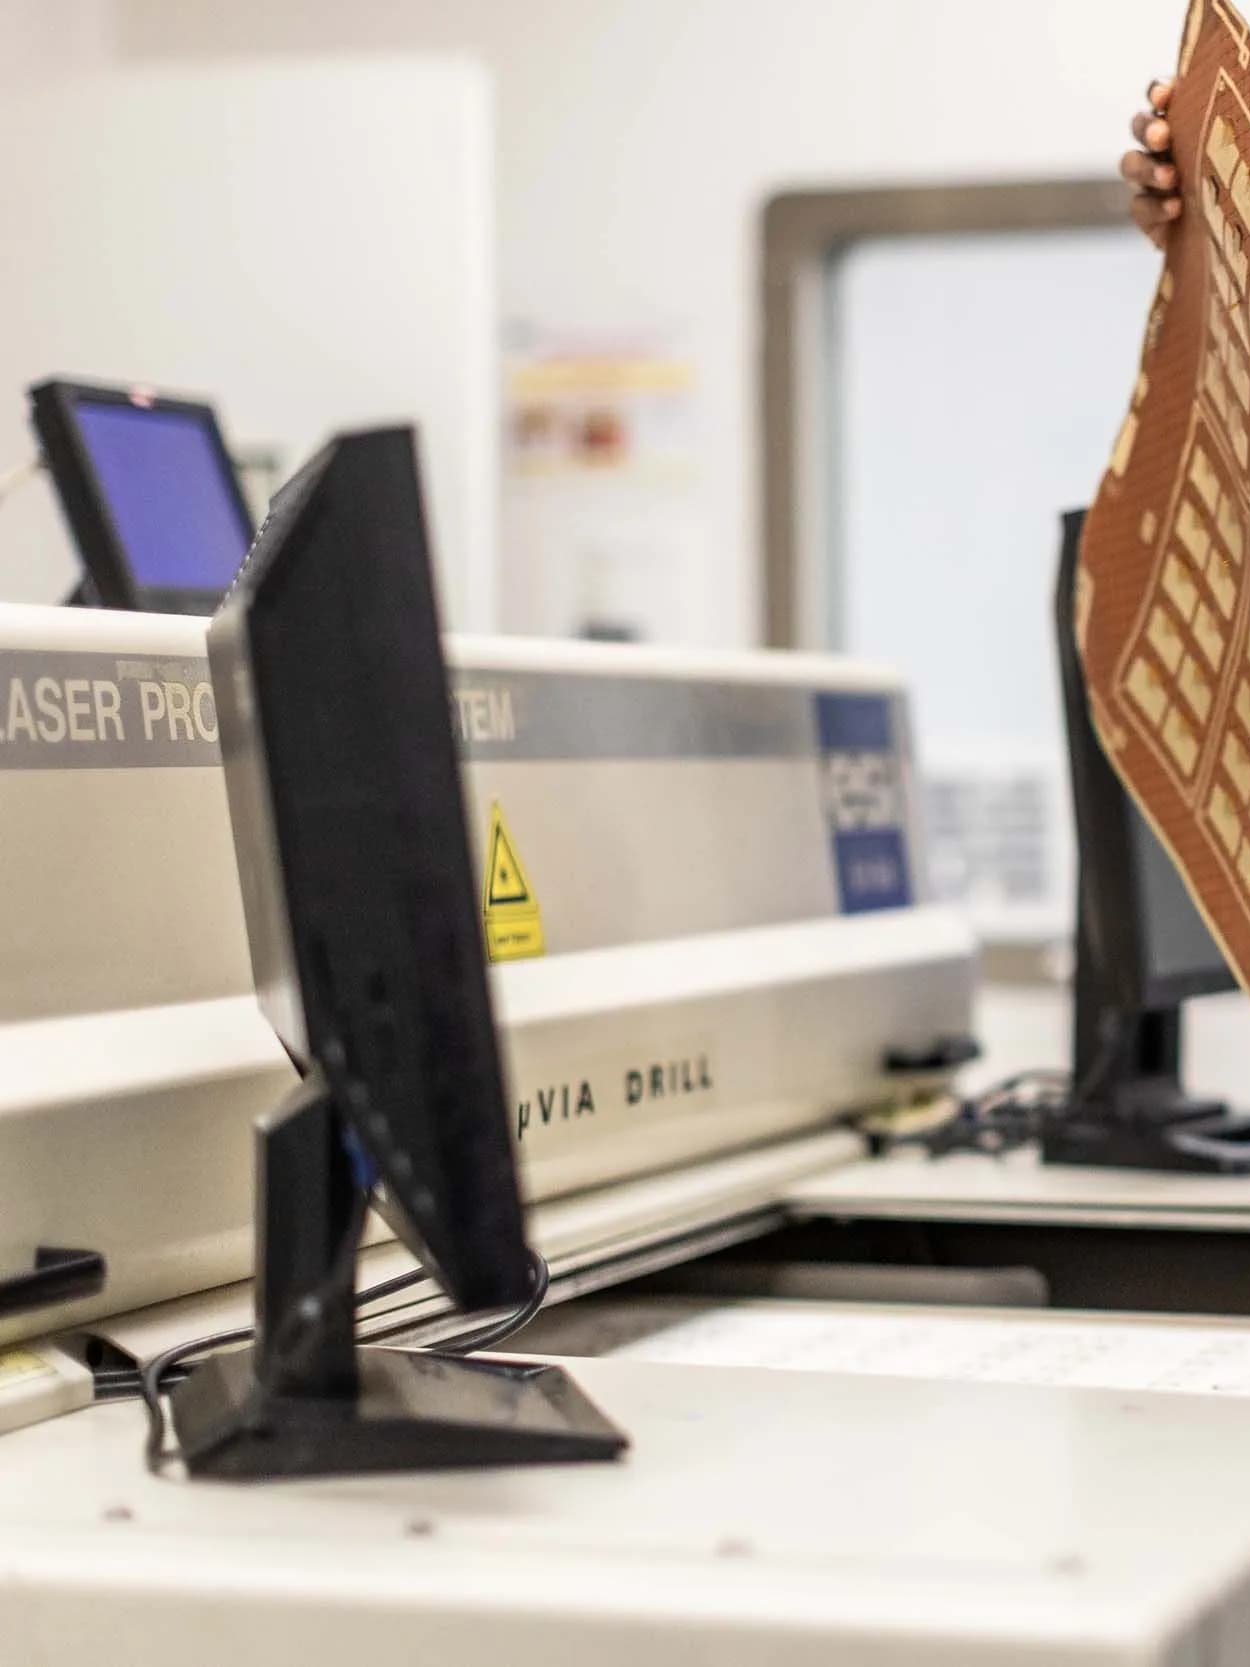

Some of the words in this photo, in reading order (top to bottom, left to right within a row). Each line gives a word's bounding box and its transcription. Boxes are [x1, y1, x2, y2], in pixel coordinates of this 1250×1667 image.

[0, 677, 125, 743] ASER
[138, 680, 219, 743] PRO
[451, 688, 515, 741] TEM
[624, 1054, 713, 1106] DRILL
